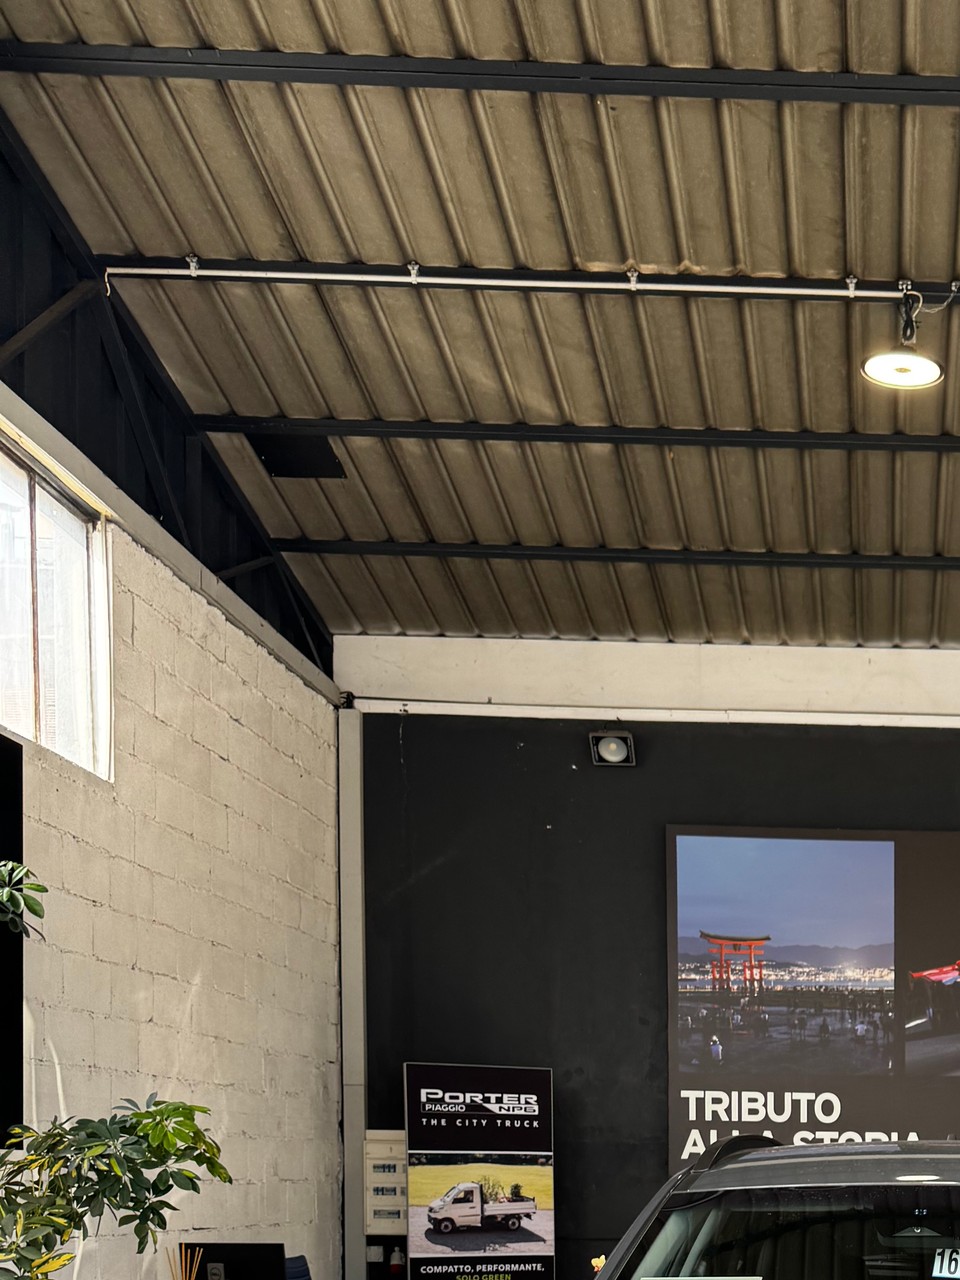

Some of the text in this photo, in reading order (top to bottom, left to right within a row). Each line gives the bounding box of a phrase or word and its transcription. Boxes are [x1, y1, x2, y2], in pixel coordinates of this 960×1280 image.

[420, 1088, 538, 1105] PORTER
[425, 1103, 466, 1112] PIAGGIO
[498, 1105, 537, 1114] NP6
[680, 1090, 842, 1124] TRIBUTO
[421, 1118, 540, 1128] THE CITY TRUCK
[420, 1263, 545, 1274] COMPATTO, PERFORMANTE,
